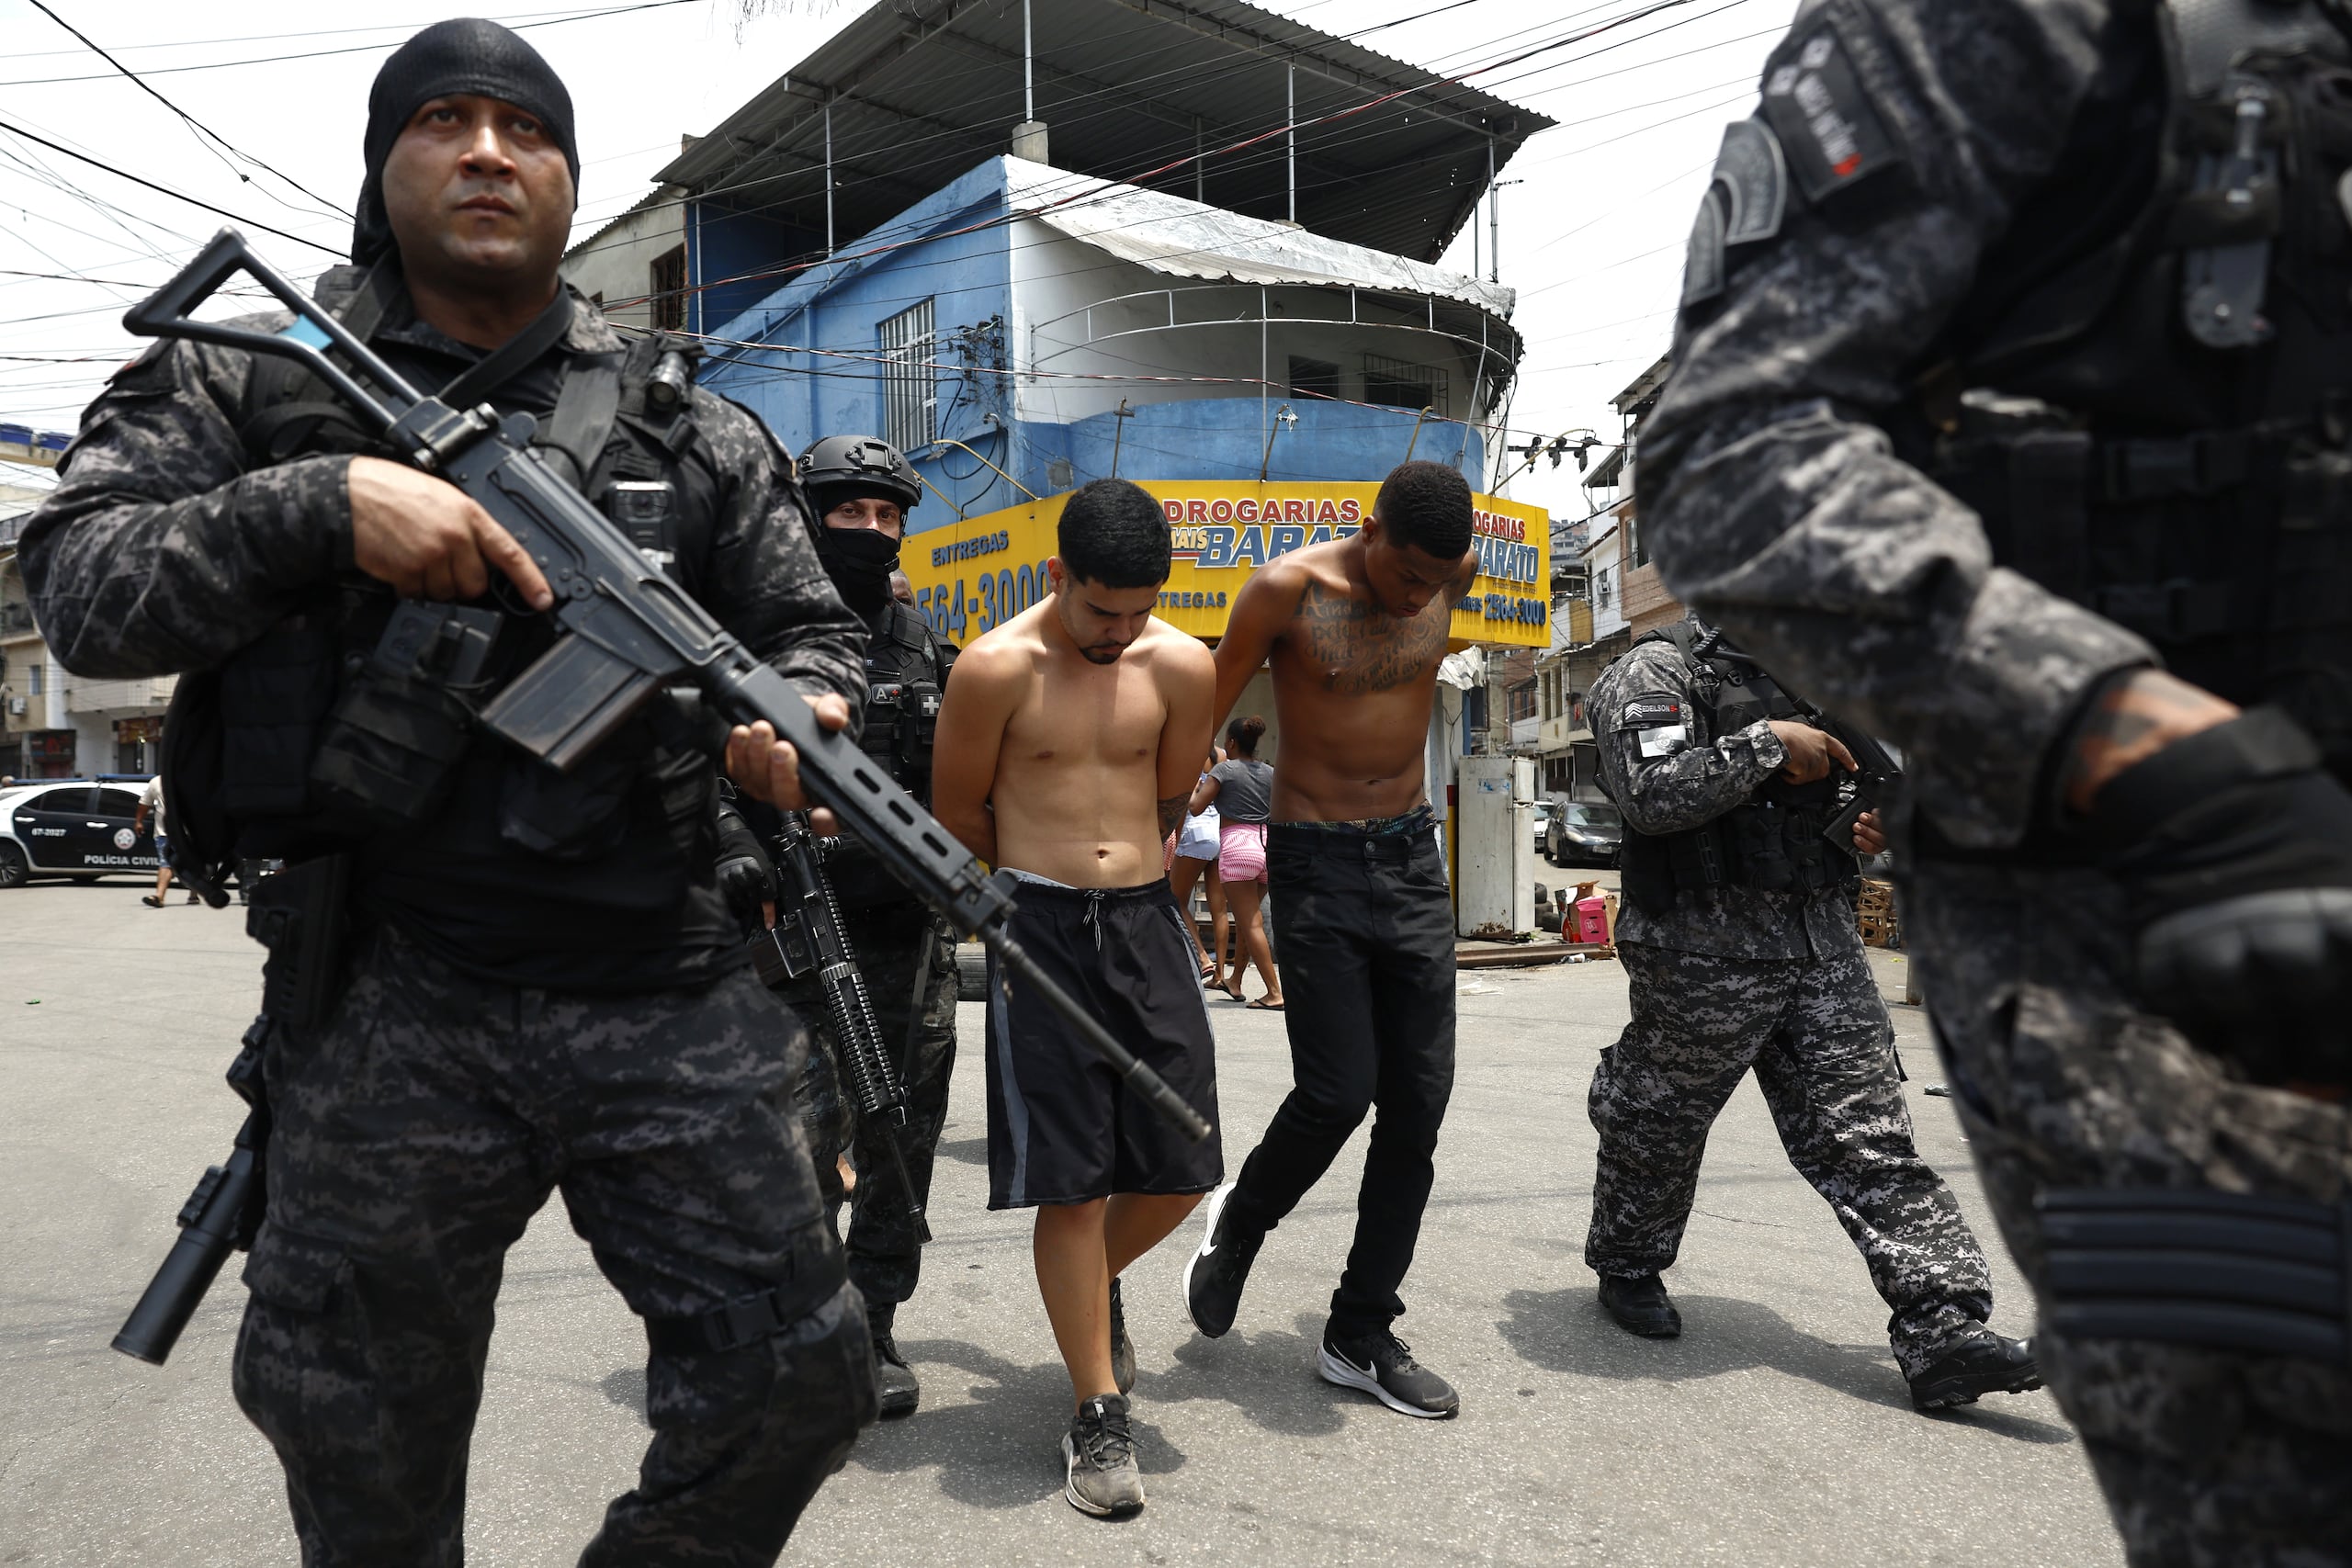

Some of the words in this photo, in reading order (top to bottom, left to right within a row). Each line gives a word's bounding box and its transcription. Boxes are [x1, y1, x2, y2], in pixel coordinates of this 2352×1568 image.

[1162, 499, 1361, 525] DROGARIAS
[1472, 508, 1525, 542] OGARIAS
[932, 530, 1009, 568] ENTREGAS
[914, 559, 1050, 638] 564-3000
[1155, 592, 1227, 608] TREGAS
[1484, 593, 1546, 626] 2564-3000
[84, 853, 130, 865] POLÍCIA
[131, 857, 161, 866] CIVIL
